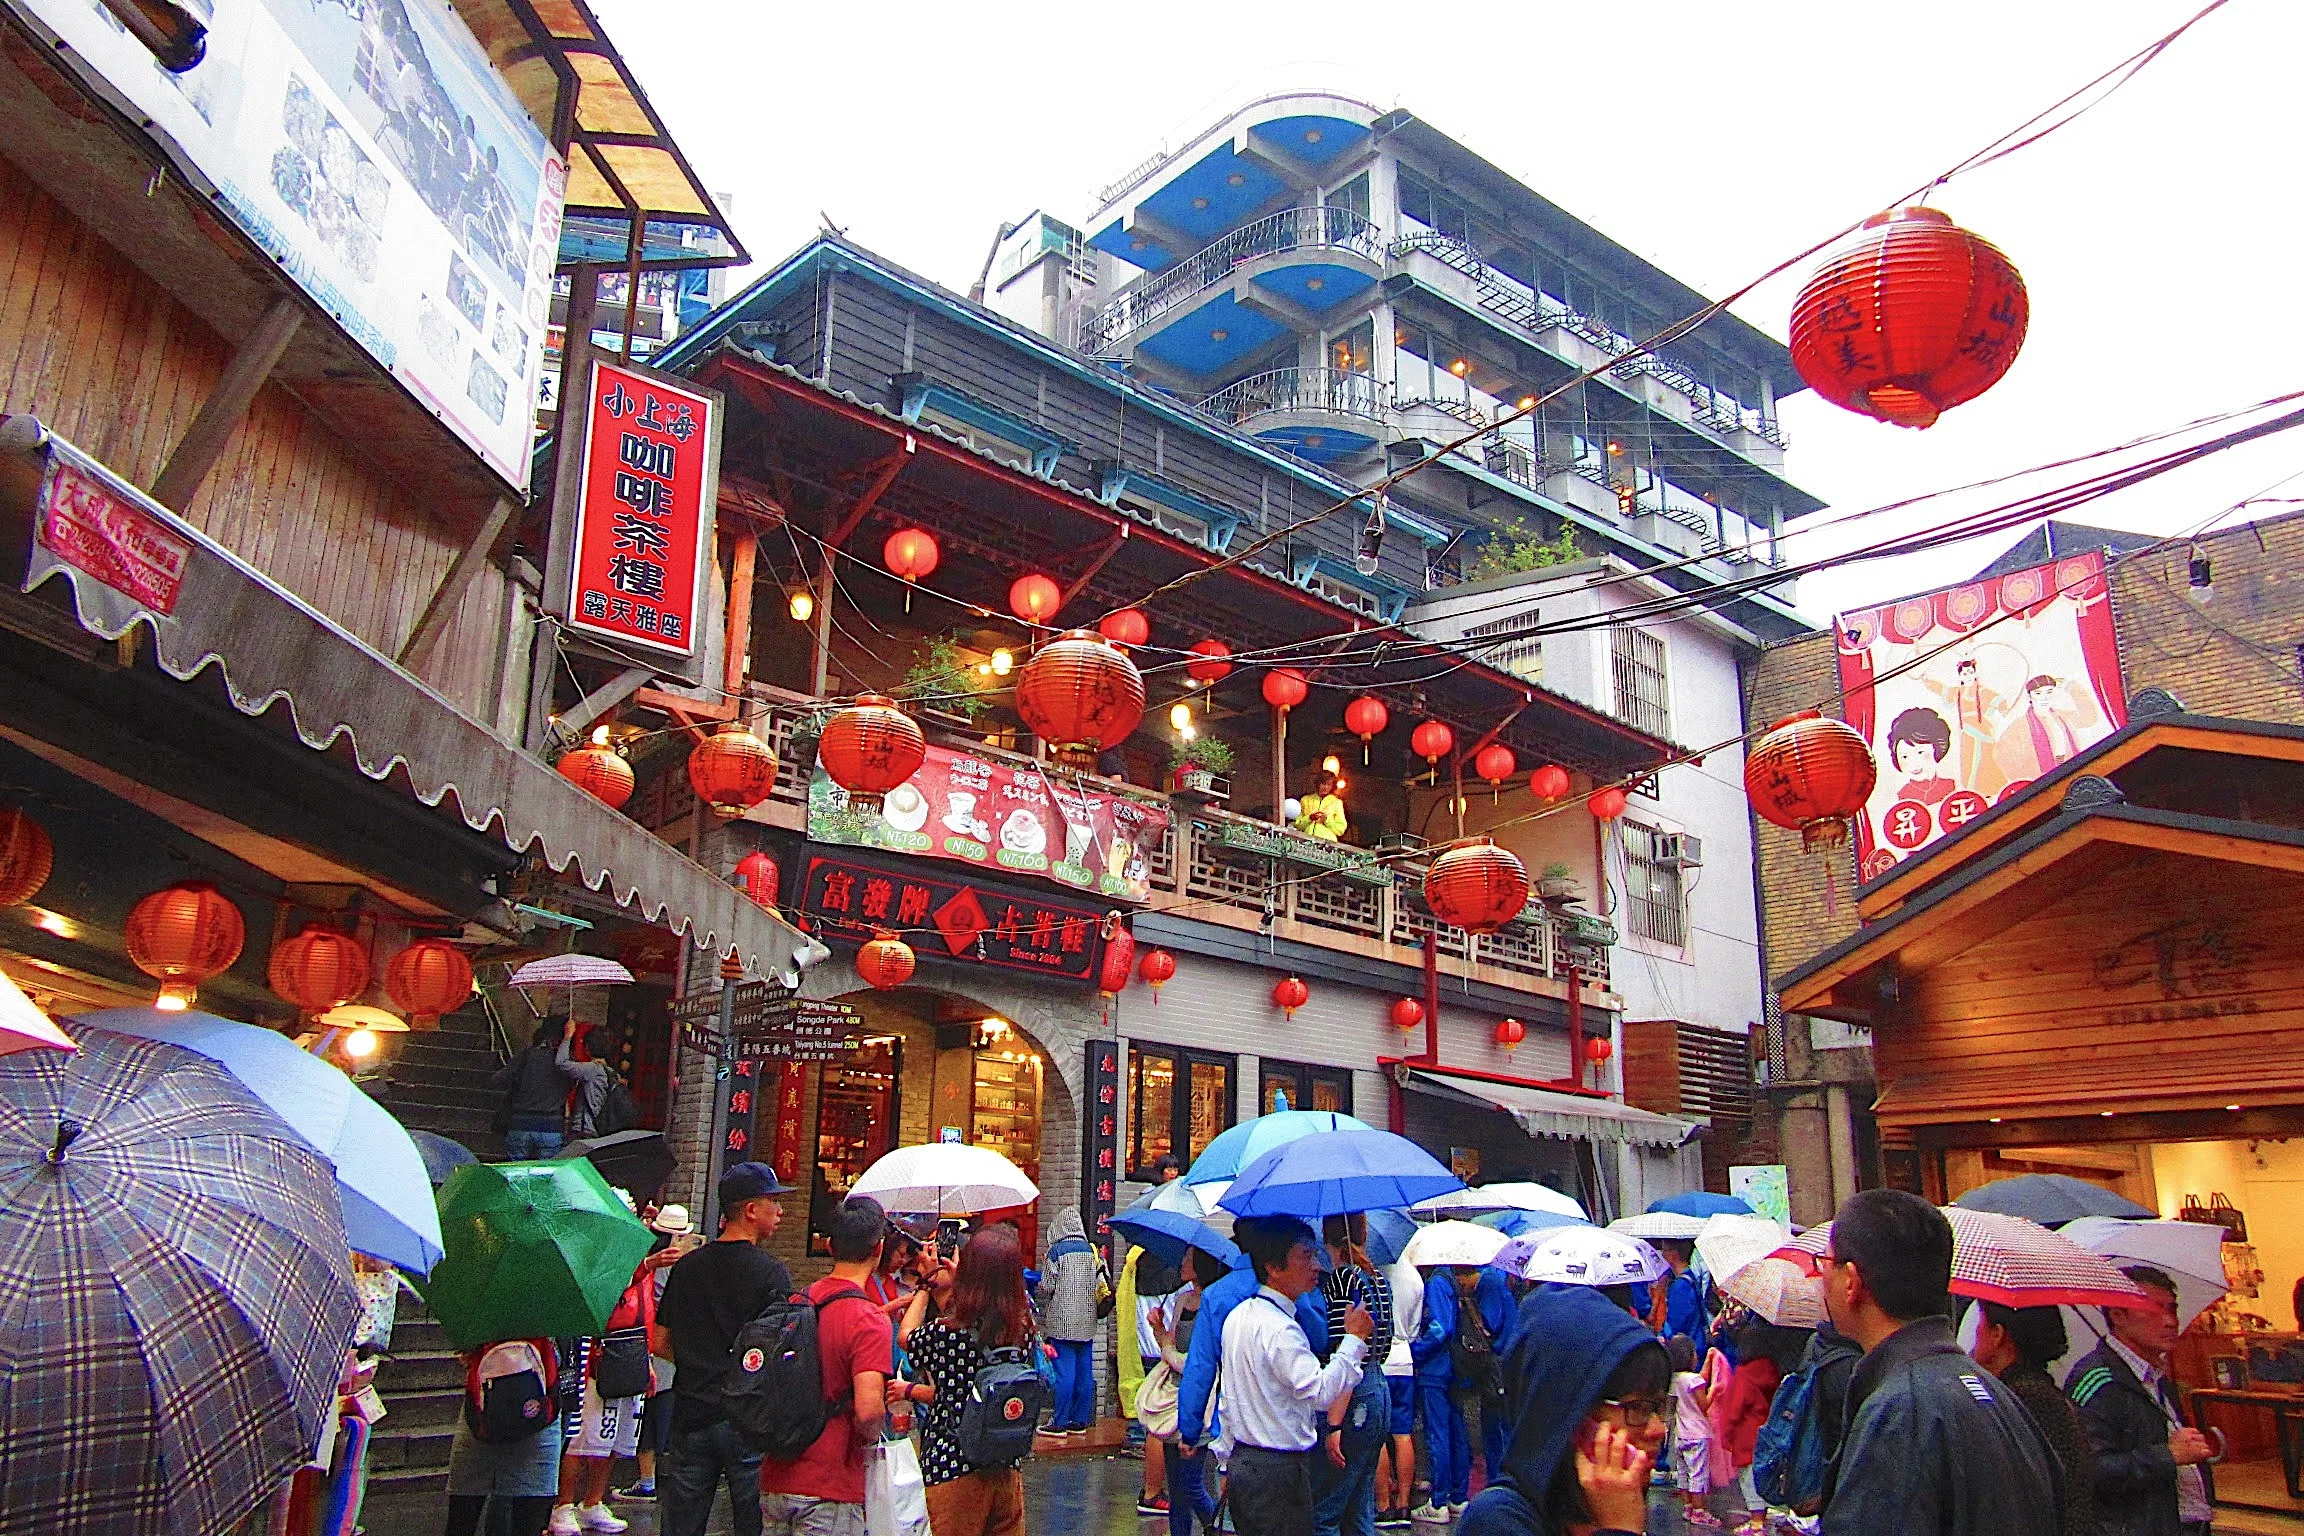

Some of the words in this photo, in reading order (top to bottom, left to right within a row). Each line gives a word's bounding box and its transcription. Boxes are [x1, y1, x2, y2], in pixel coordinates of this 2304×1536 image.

[603, 383, 698, 443] 小上海
[609, 432, 676, 602] 咖啡茶樓
[582, 590, 684, 641] 露天雅座
[951, 758, 992, 777] 烏龍茶
[1013, 772, 1040, 789] 花茶
[822, 870, 931, 926] 富發牌
[1010, 947, 1037, 961] Since
[821, 1003, 838, 1012] Theater
[827, 1016, 844, 1024] Park
